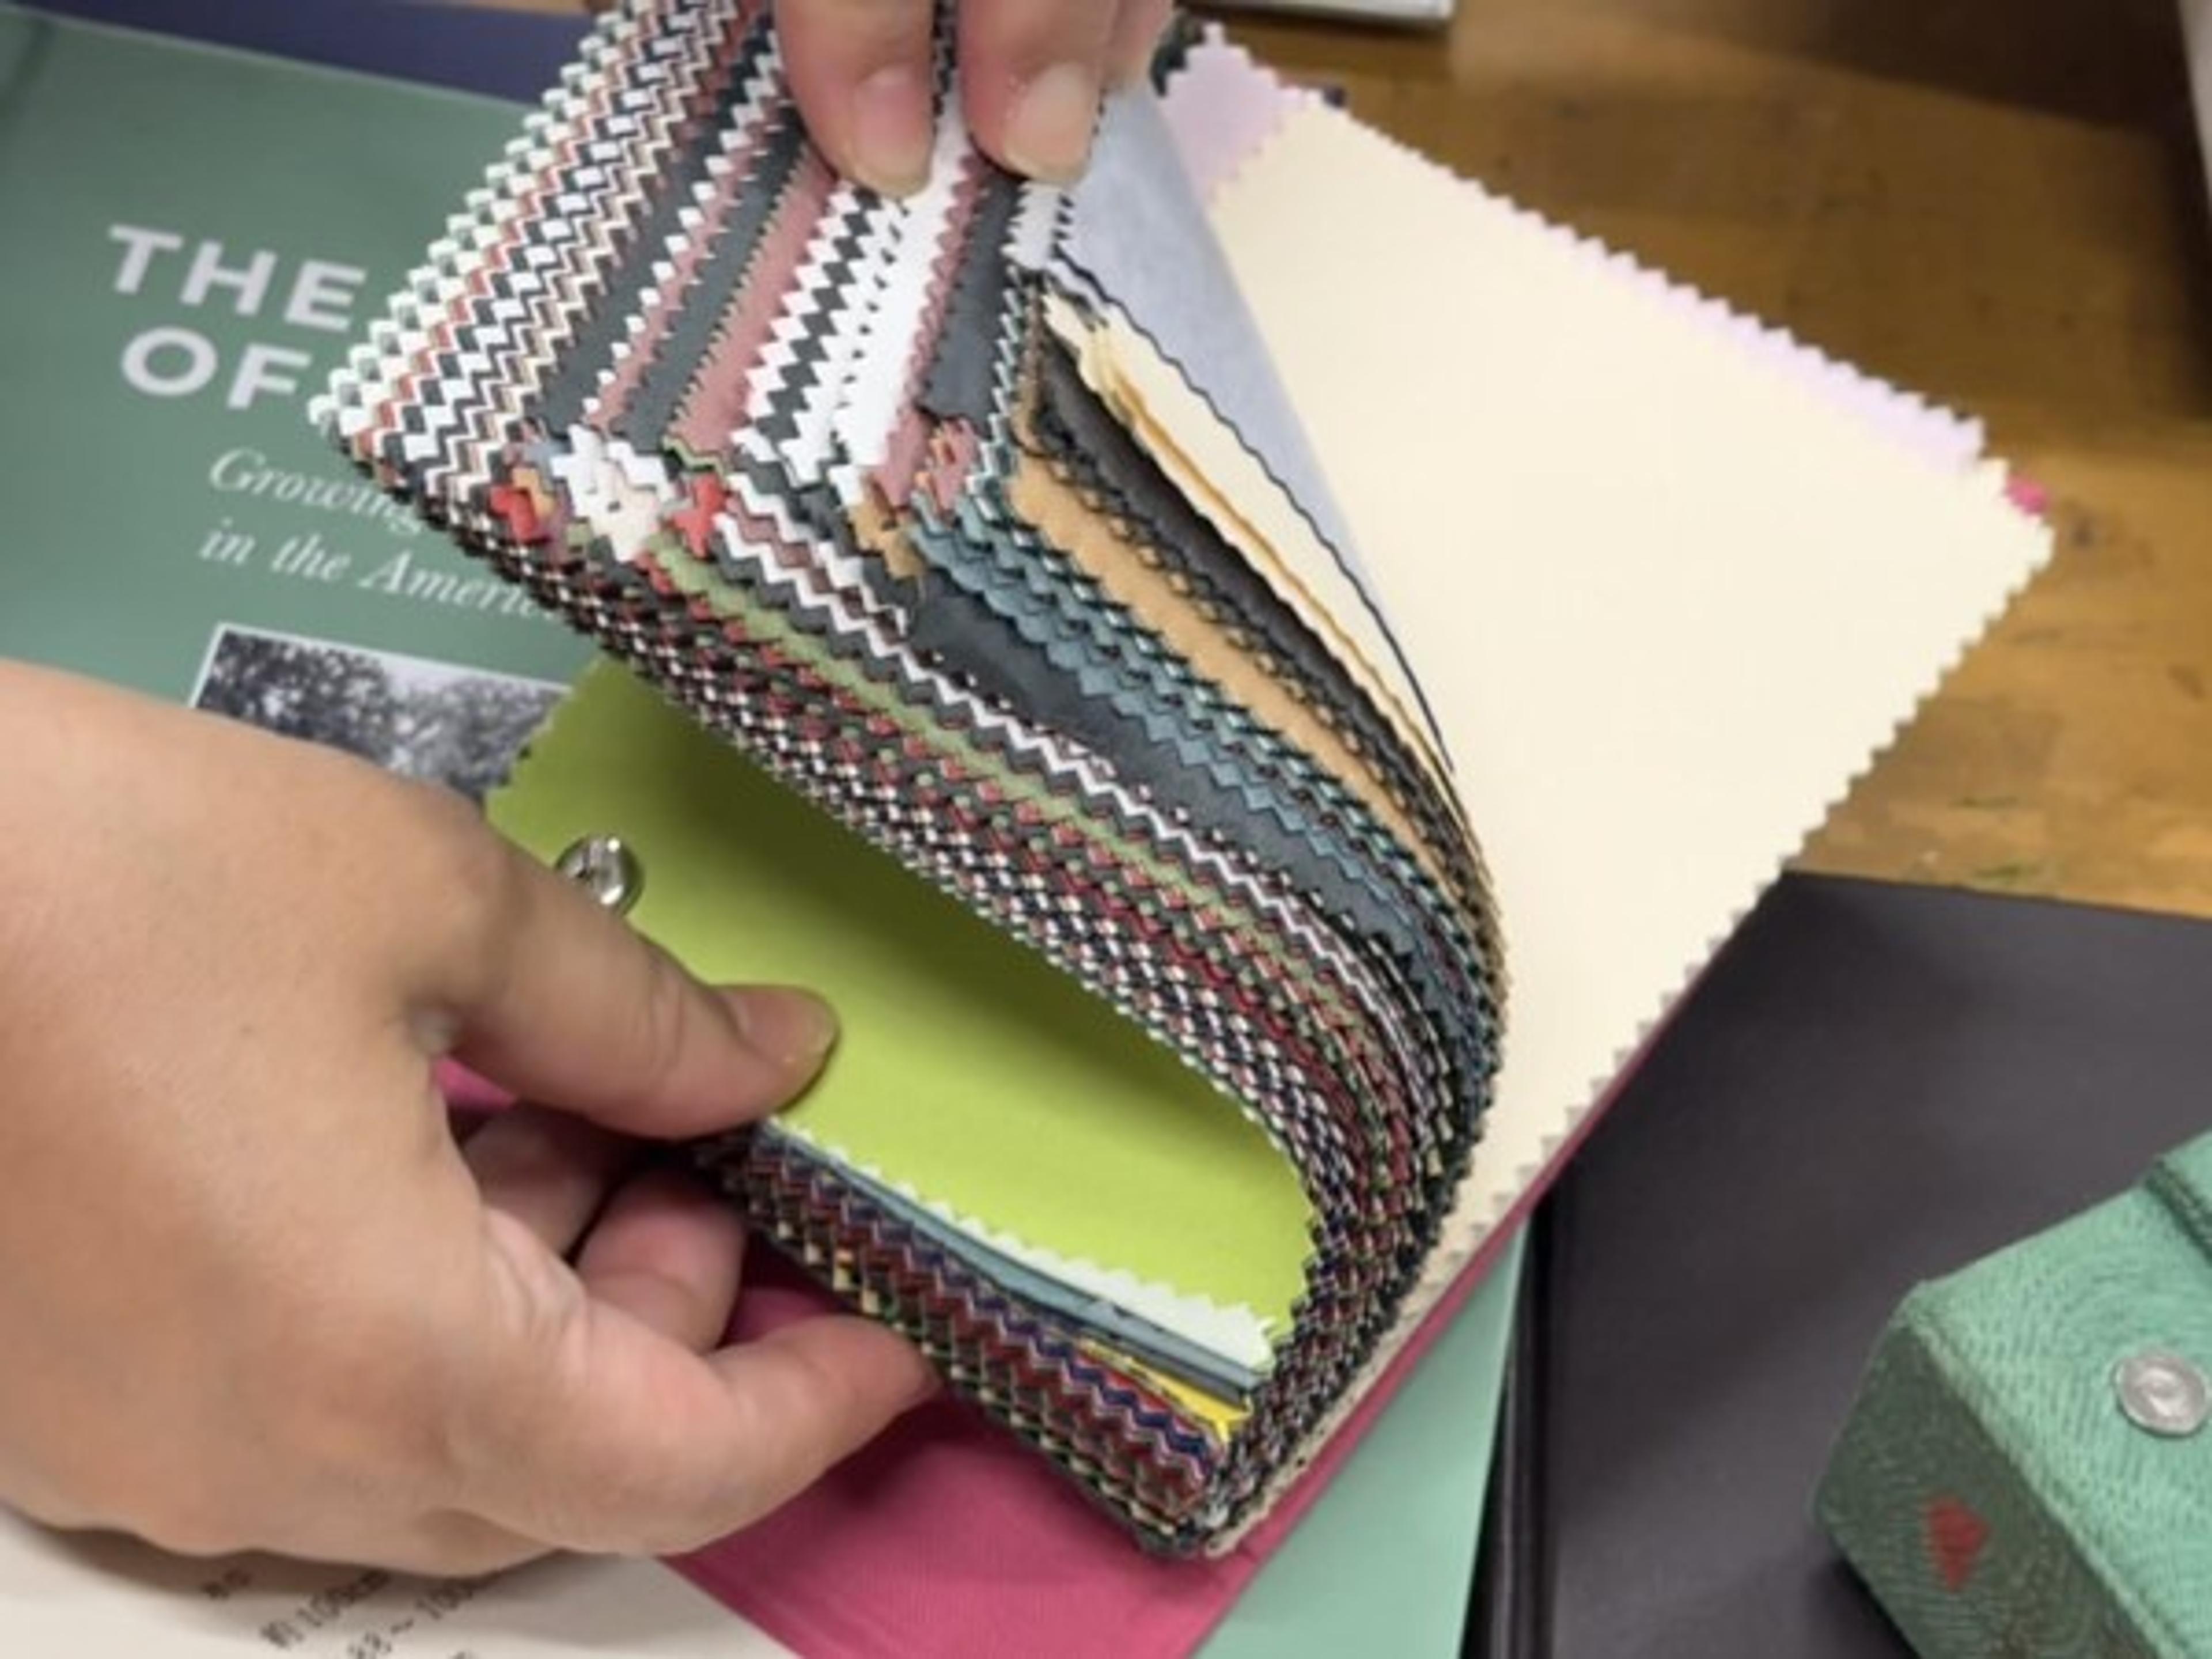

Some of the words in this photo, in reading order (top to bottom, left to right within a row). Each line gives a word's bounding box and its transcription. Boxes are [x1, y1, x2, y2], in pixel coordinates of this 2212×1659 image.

[110, 225, 365, 331] THE
[122, 327, 311, 410] OF
[199, 518, 255, 563] in
[271, 533, 351, 580] the
